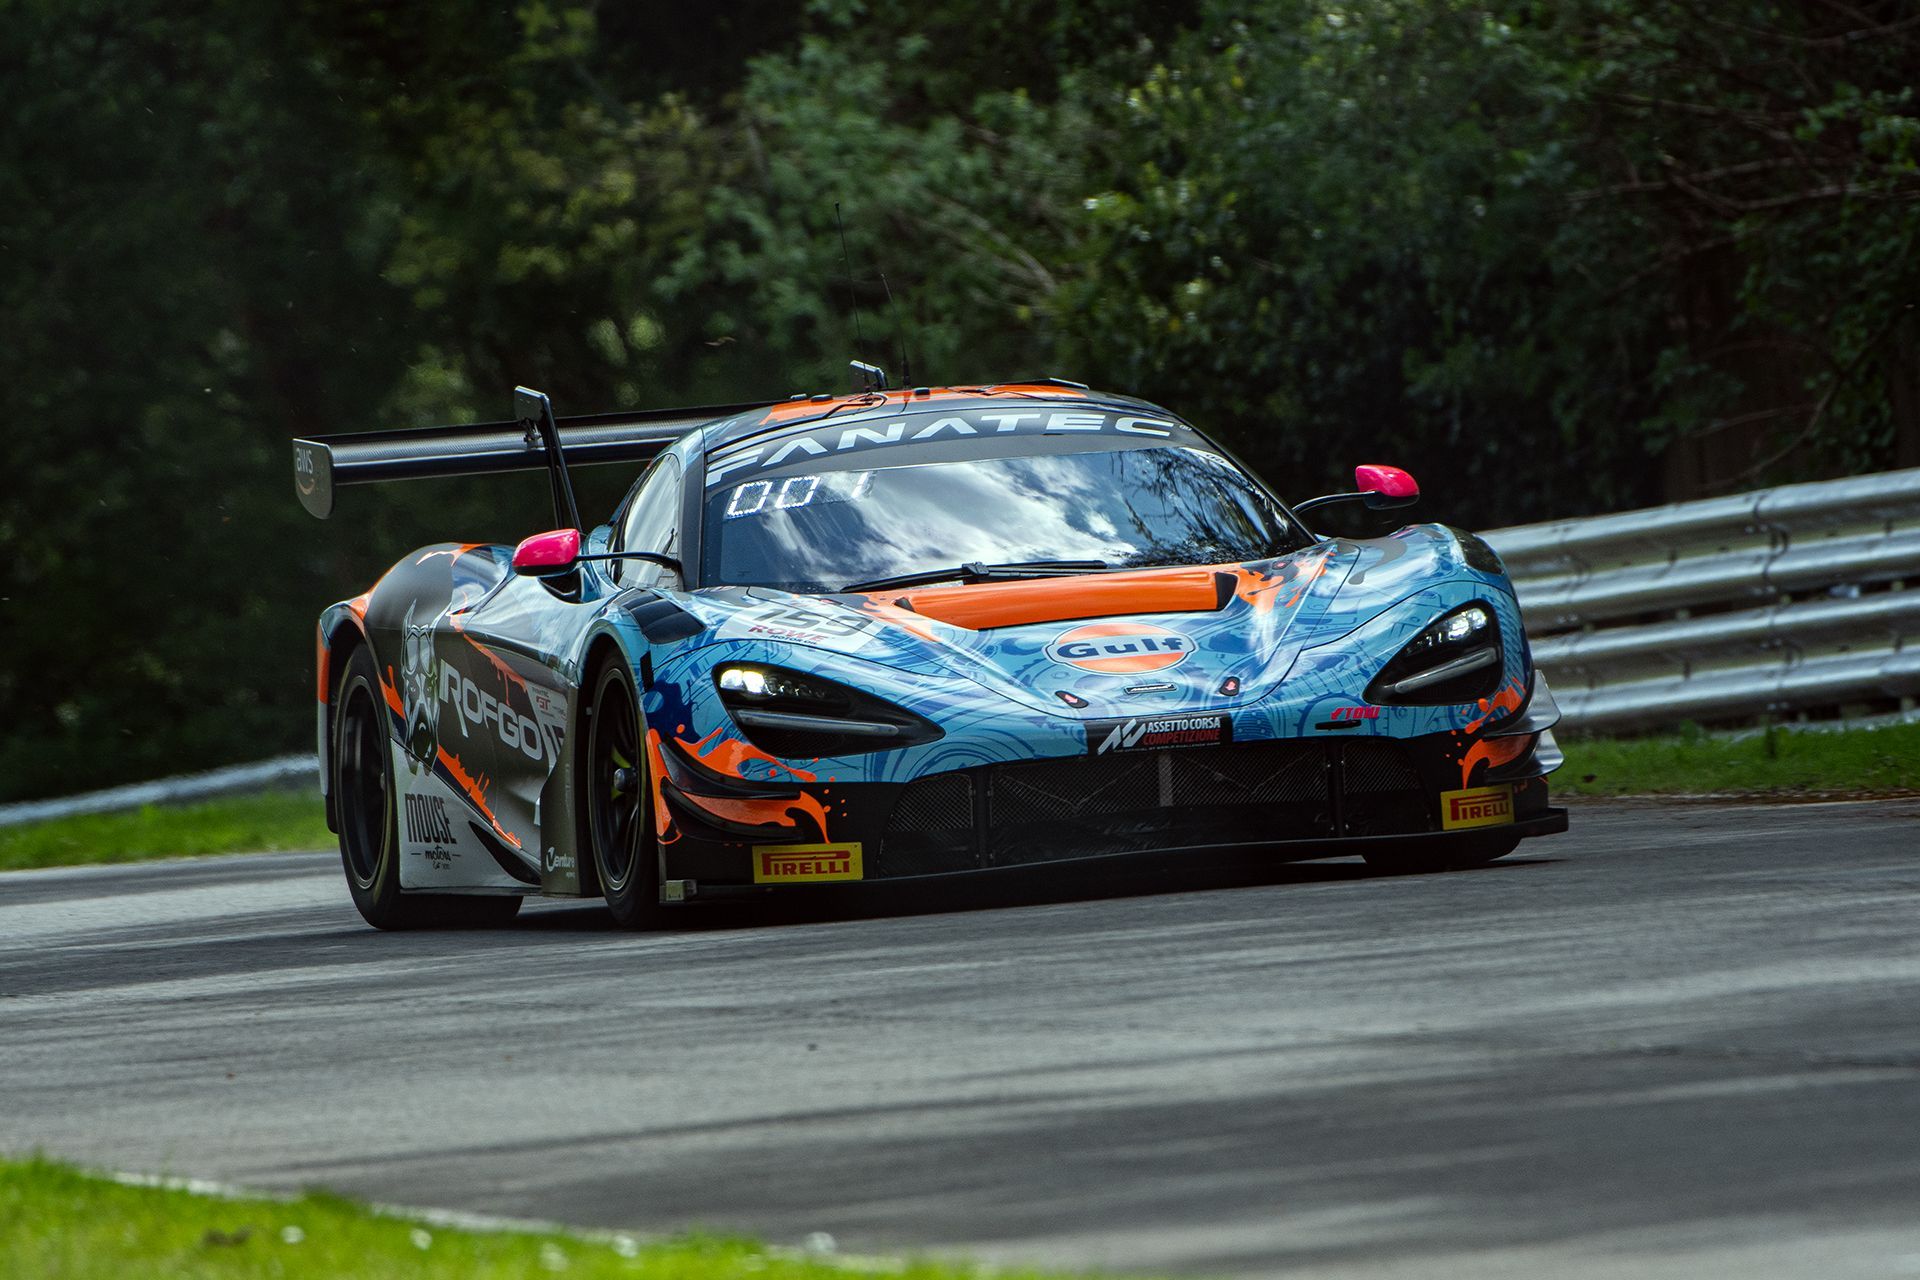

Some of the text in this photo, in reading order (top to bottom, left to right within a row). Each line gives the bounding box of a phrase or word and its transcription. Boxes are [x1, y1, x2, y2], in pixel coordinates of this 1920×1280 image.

[296, 447, 314, 475] aws
[704, 412, 1176, 486] FANATEC
[748, 624, 829, 643] ROWE
[769, 634, 802, 644] MOTOR
[1057, 637, 1184, 659] Gulf
[438, 658, 544, 761] ROFGO
[1345, 705, 1381, 719] TOW
[1142, 728, 1221, 745] COMPETIZIONE
[1146, 716, 1221, 734] ASSETTO CORSA
[1450, 791, 1509, 821] PIRELLI
[404, 792, 458, 845] MOUSE
[761, 850, 851, 876] PIRELLI
